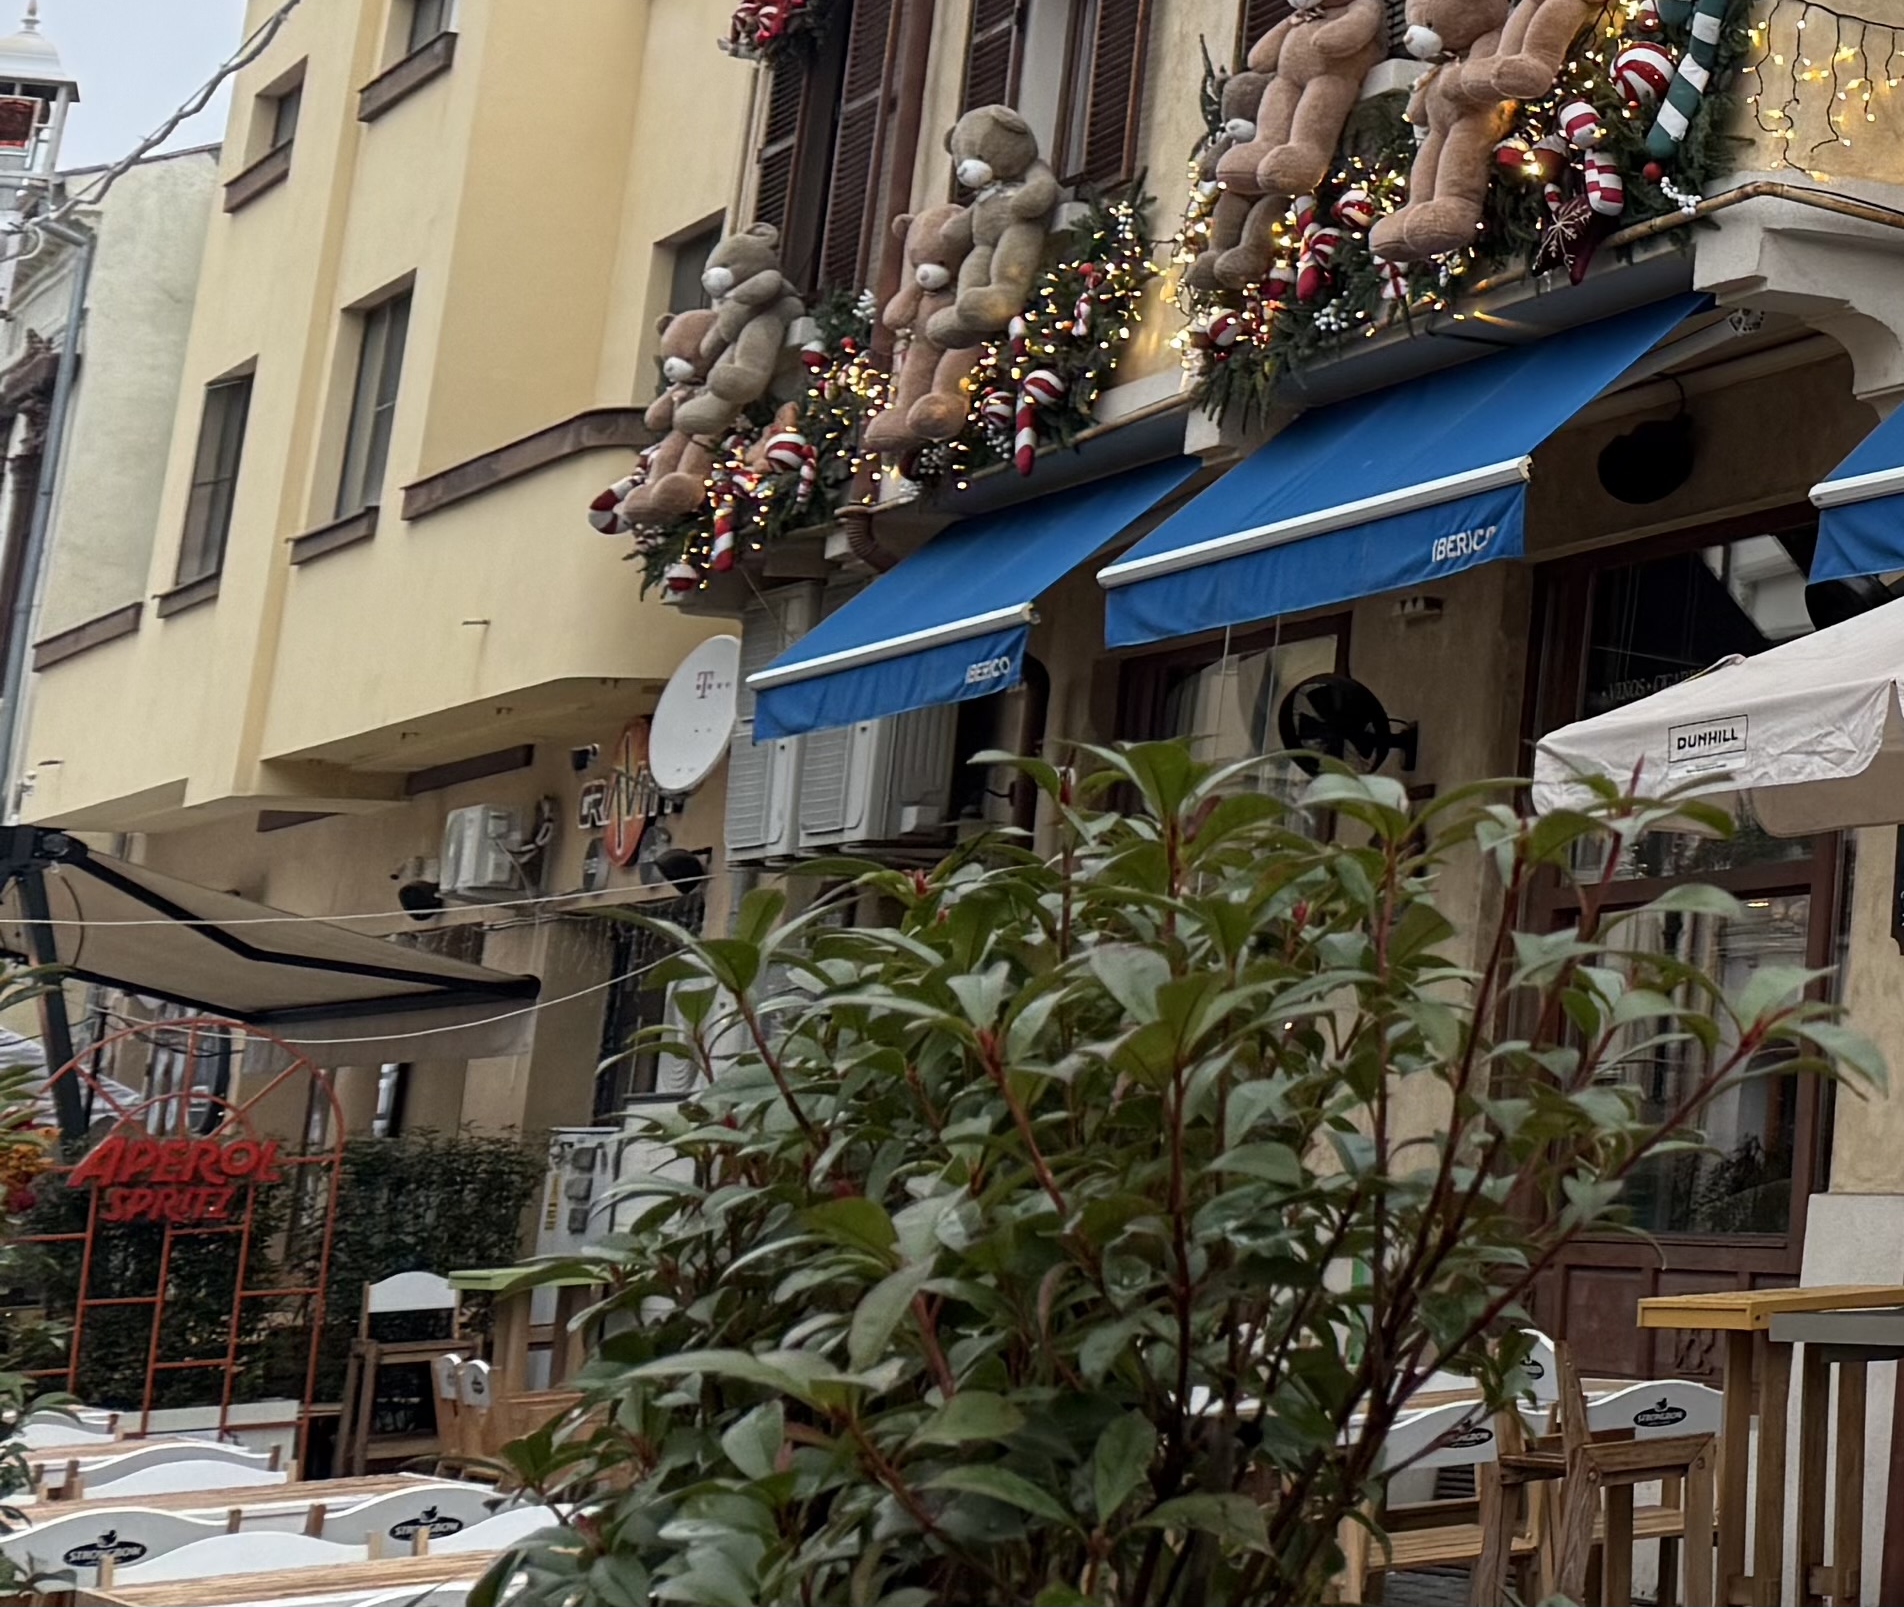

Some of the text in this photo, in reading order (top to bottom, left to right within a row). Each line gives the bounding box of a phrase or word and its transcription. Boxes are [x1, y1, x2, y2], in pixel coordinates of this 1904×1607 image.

[1676, 727, 1739, 751] DUNHILL
[65, 1134, 281, 1188] APEROL
[100, 1186, 236, 1223] SPRITZ
